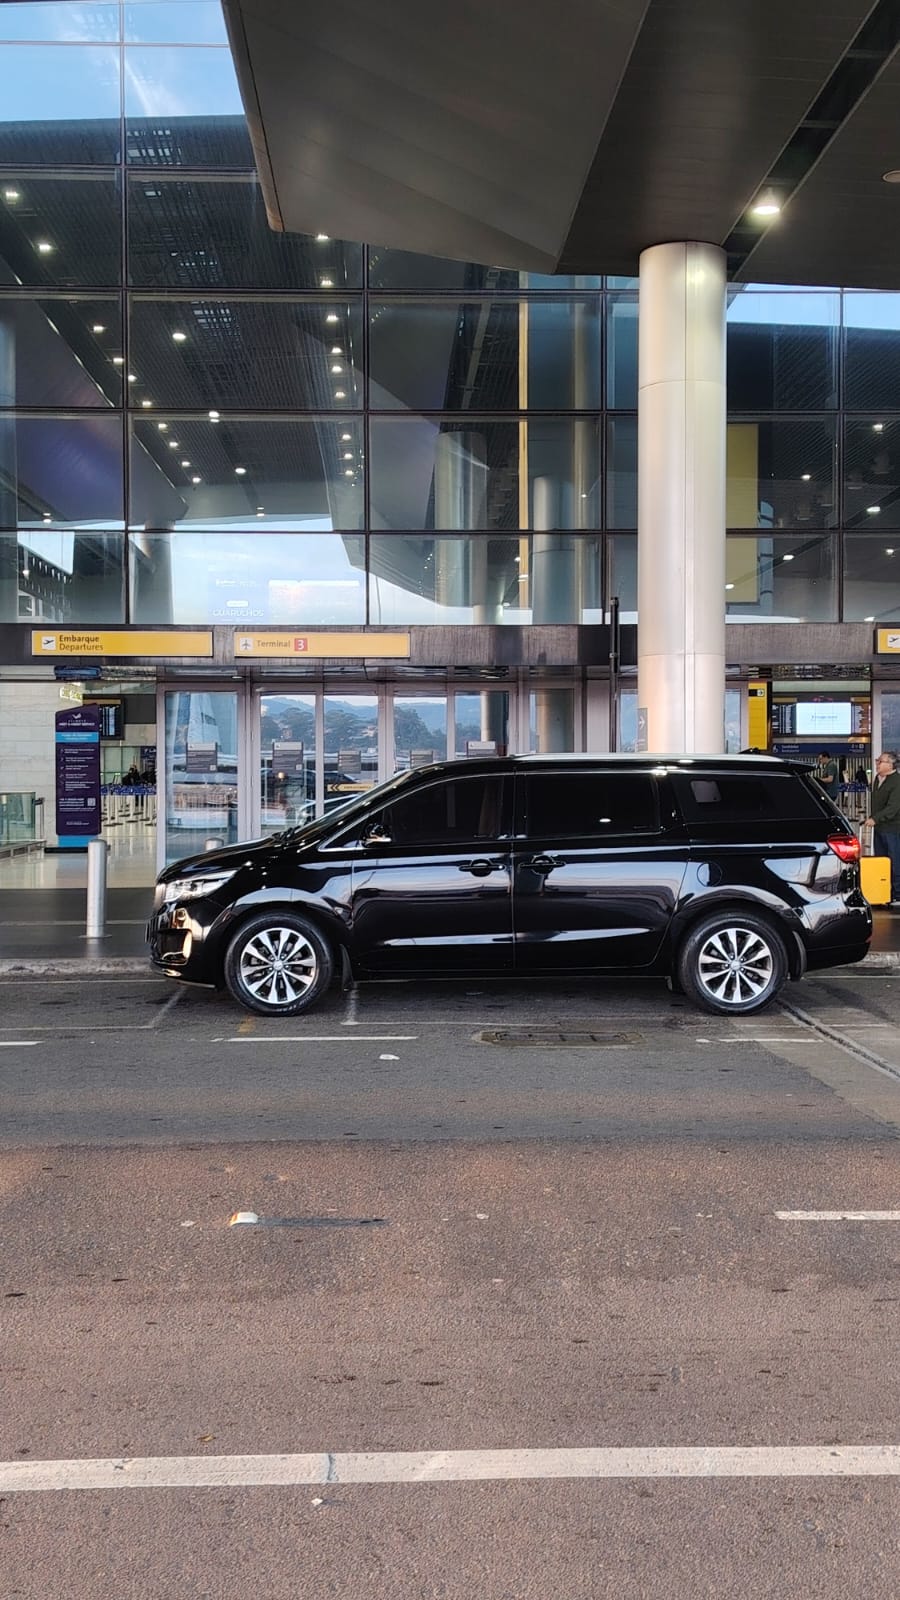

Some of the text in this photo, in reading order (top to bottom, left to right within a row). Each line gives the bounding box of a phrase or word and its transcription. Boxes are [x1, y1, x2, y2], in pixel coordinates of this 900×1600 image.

[59, 634, 99, 643] Embarque
[59, 643, 104, 652] Departures
[257, 639, 305, 650] Terminal 3
